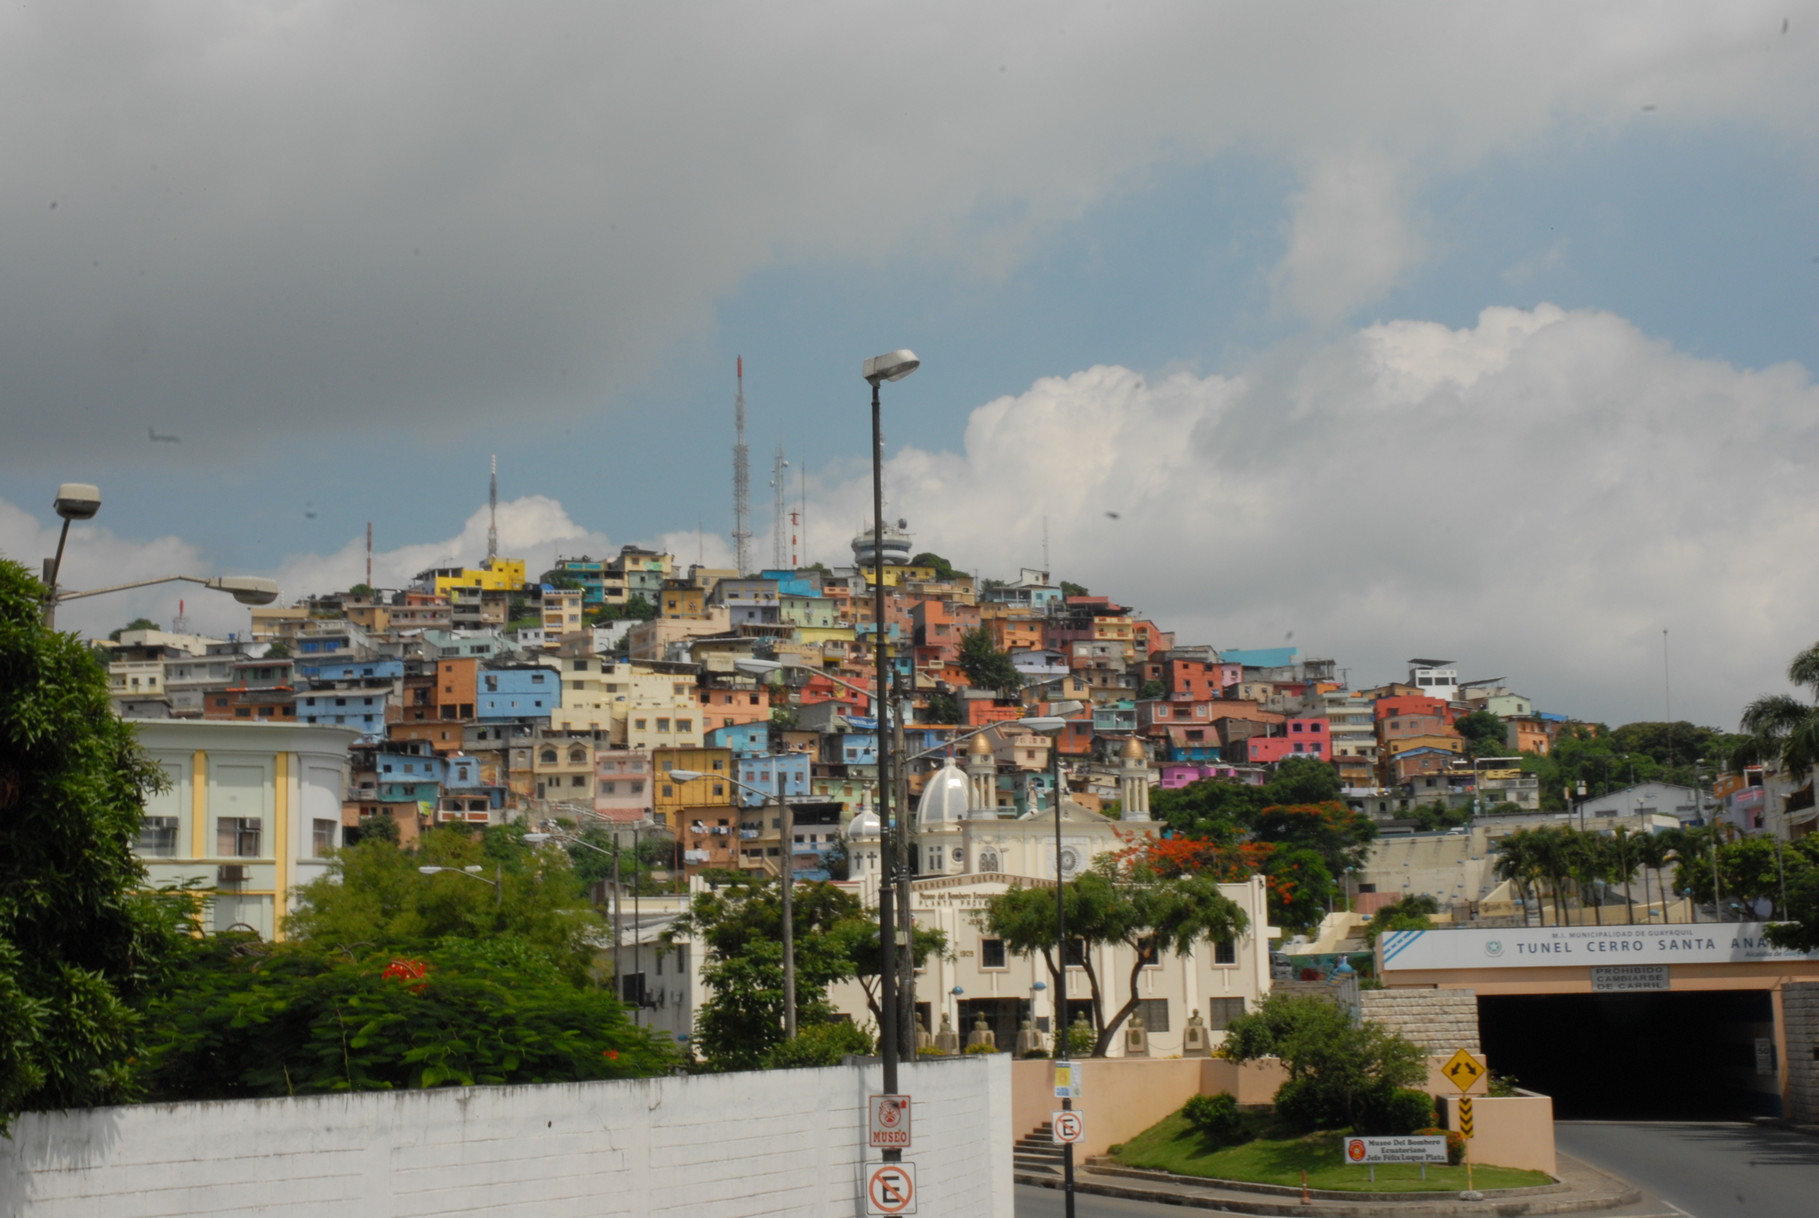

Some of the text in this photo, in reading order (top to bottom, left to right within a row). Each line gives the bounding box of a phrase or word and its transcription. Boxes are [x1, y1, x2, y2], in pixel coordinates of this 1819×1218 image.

[1569, 931, 1633, 939] MUNICIPALIDAD
[1648, 929, 1694, 937] GUAYAQUIL
[1517, 938, 1767, 953] TUNEL CERRO SANTA ANA
[1596, 967, 1663, 975] PROHIBIDO
[1063, 1118, 1074, 1136] E
[873, 1131, 908, 1143] MUSEO
[1381, 1146, 1427, 1154] Ecuatoriano
[882, 1175, 900, 1203] E
